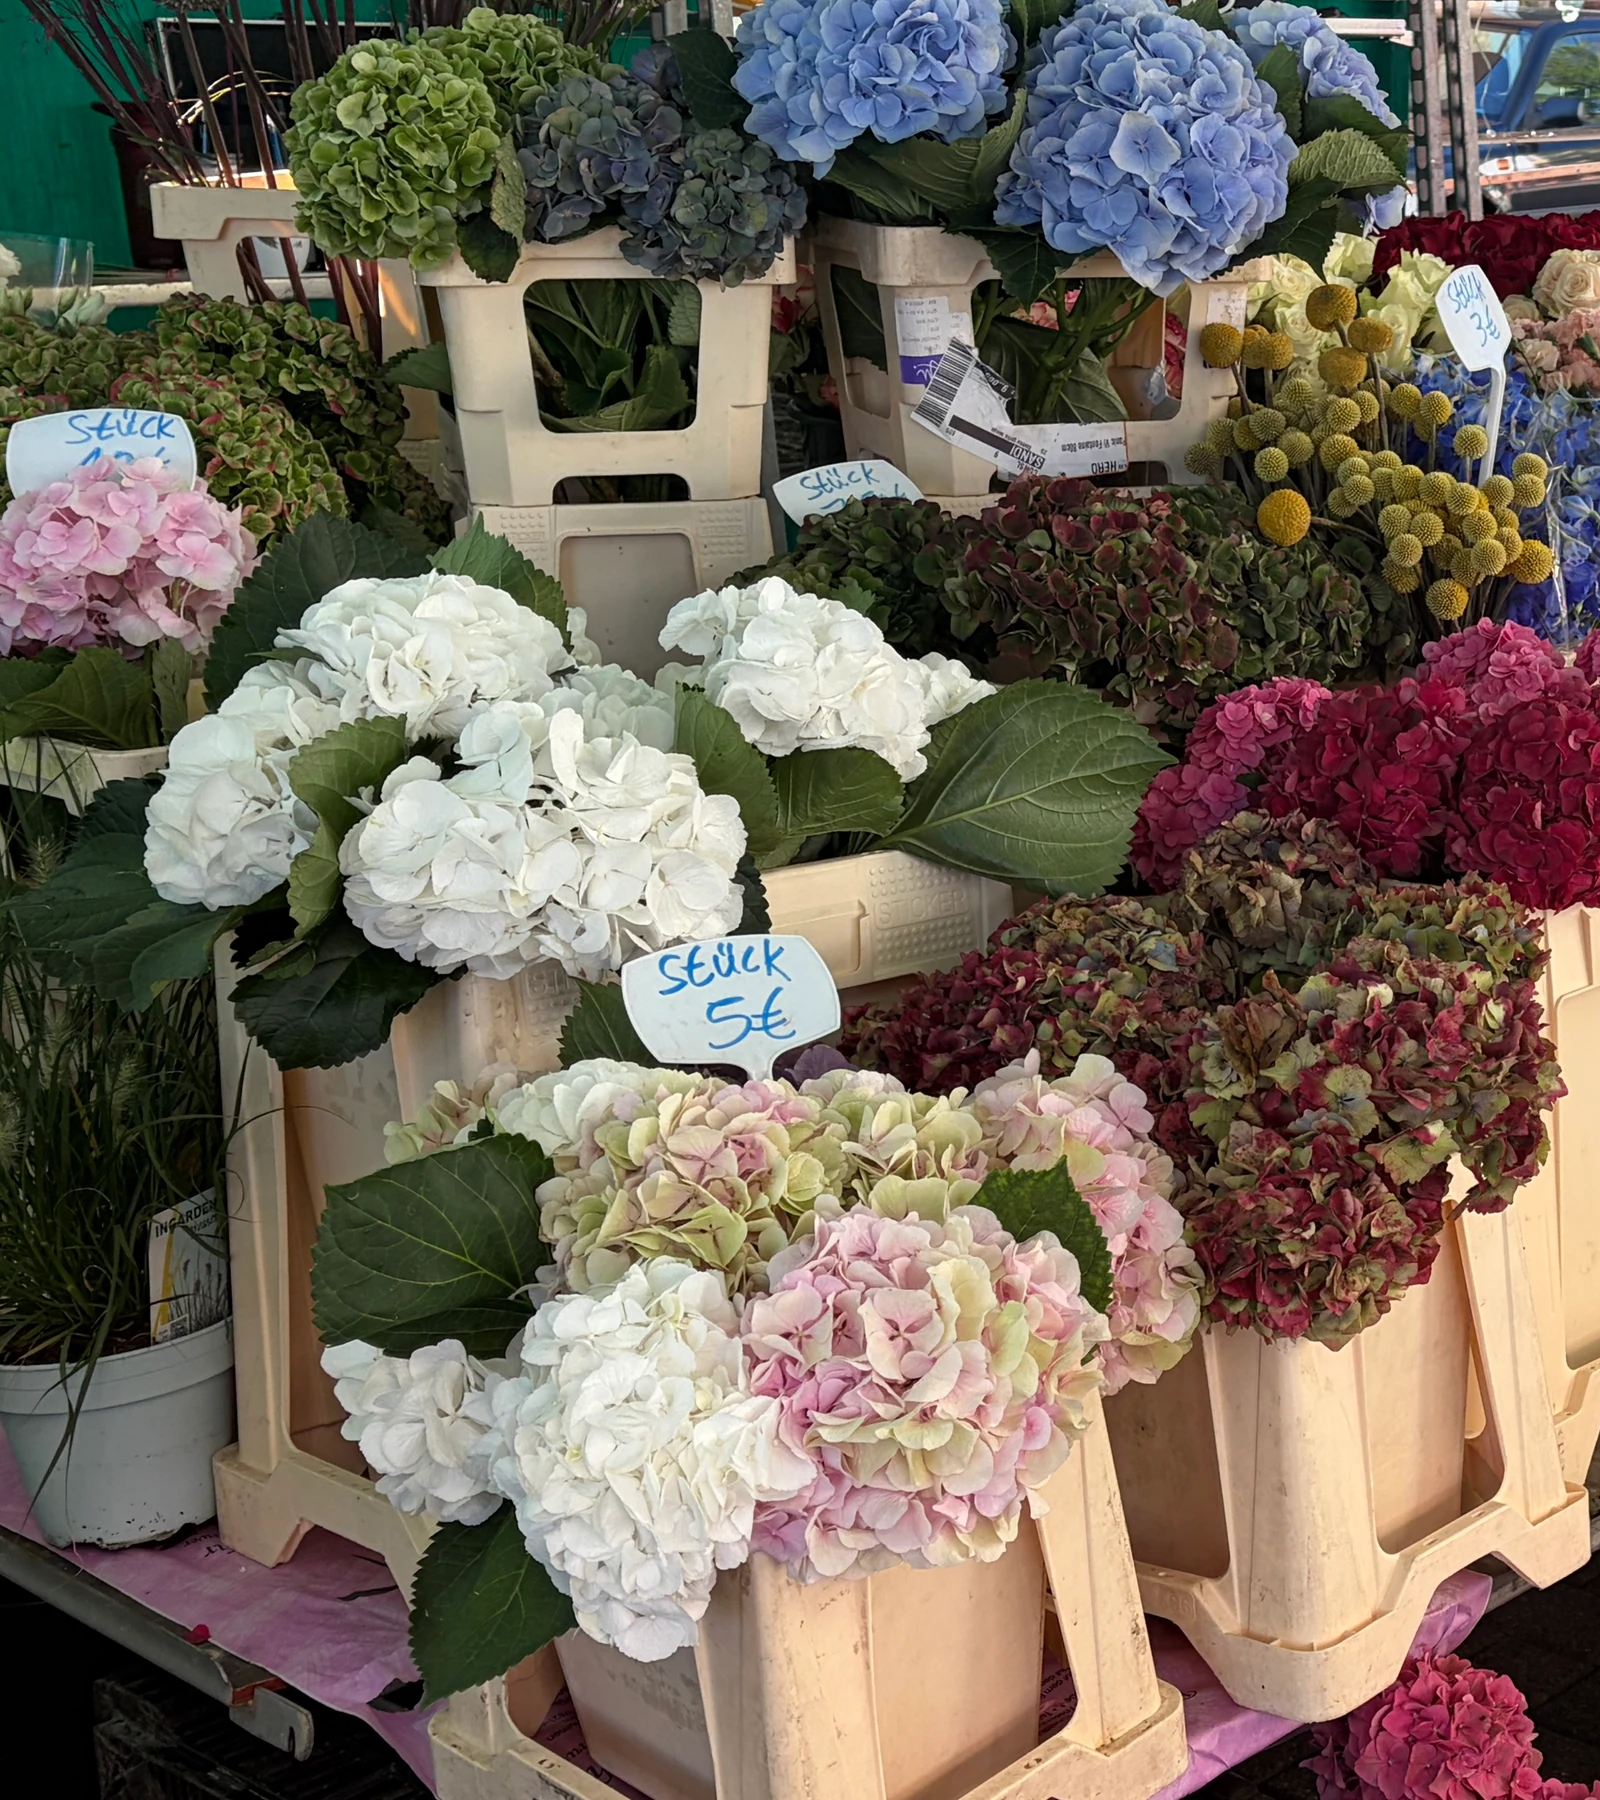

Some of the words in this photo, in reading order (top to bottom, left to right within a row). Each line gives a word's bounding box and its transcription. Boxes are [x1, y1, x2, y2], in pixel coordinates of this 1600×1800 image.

[1448, 271, 1487, 314] Stück
[1470, 304, 1500, 347] 3€
[65, 409, 176, 444] Stück
[800, 463, 880, 500] Stück
[1091, 460, 1117, 474] HERO
[658, 938, 792, 996] Stück
[706, 986, 796, 1050] 5€
